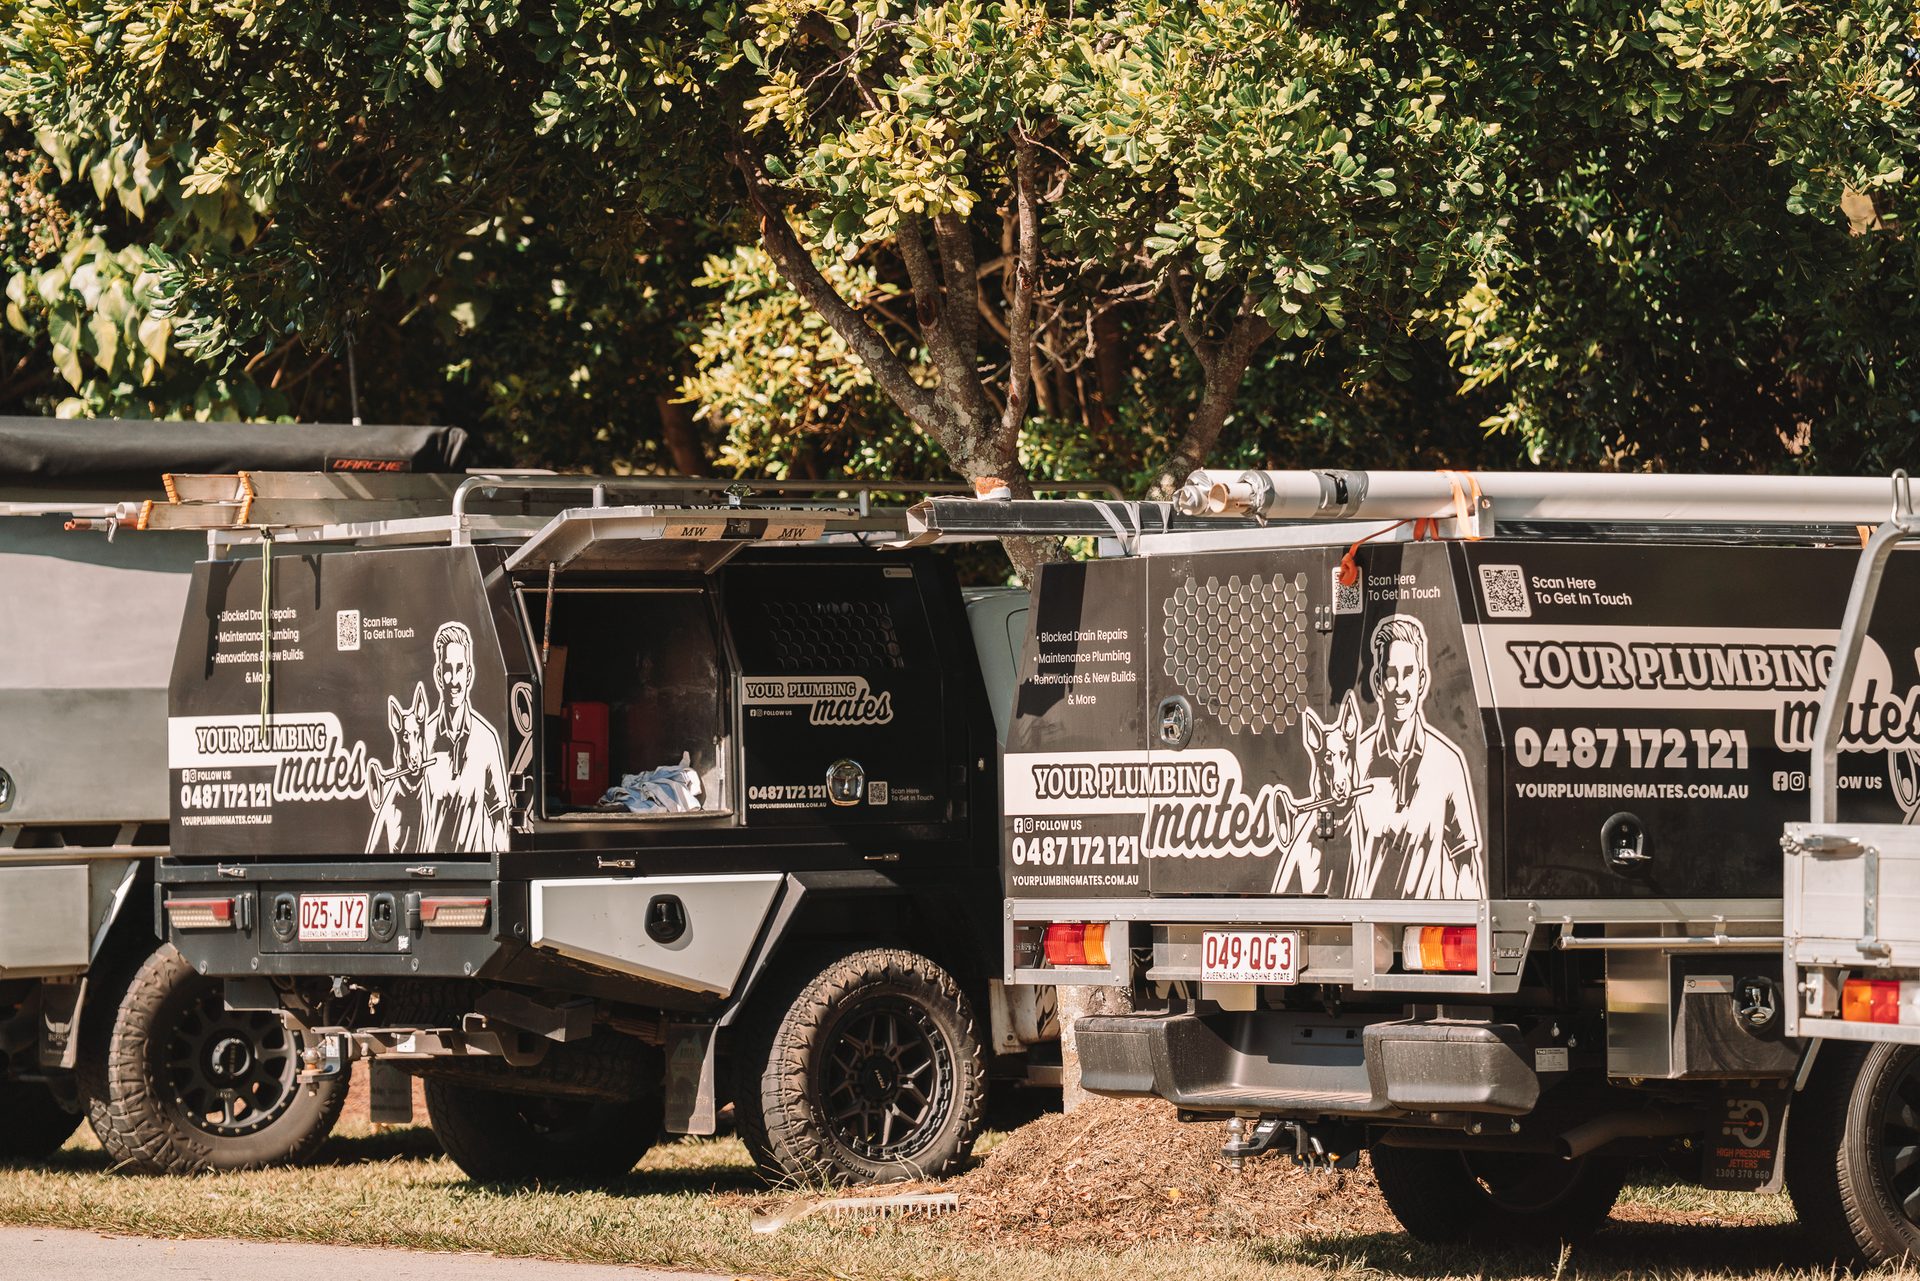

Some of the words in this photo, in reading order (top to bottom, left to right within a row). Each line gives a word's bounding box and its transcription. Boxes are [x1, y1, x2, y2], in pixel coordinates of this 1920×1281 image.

[333, 459, 403, 471] DARCHE
[1368, 576, 1396, 586] Scan
[1397, 575, 1416, 585] Here
[1532, 576, 1565, 590] Scan
[1568, 577, 1596, 590] Here
[1368, 590, 1380, 600] To
[1382, 589, 1398, 600] Get
[1400, 588, 1409, 599] In
[1411, 587, 1440, 598] Touch
[1534, 592, 1548, 604] To
[1550, 592, 1576, 604] Get
[1579, 592, 1591, 605] In
[1593, 592, 1632, 606] Touch
[221, 609, 249, 622] Blocked
[250, 608, 269, 620] Dra
[363, 618, 380, 628] Scan
[382, 617, 398, 626] Here
[219, 632, 264, 643] Maintenance
[363, 630, 372, 640] To
[373, 630, 386, 640] Get
[387, 629, 393, 639] In
[395, 628, 414, 638] Touch
[1041, 631, 1072, 642] Blocked
[1074, 630, 1096, 641] Drain
[1097, 628, 1128, 644] Repairs
[216, 652, 259, 663] Renovations
[282, 650, 304, 661] Builds
[1039, 652, 1090, 664] Maintenance
[1092, 650, 1130, 664] Plumbing
[1507, 641, 1629, 690] YOUR
[245, 672, 252, 683] &
[252, 672, 270, 683] Moe
[1034, 673, 1082, 684] Renovations
[1084, 672, 1090, 683] &
[1092, 672, 1110, 682] New
[1112, 670, 1136, 682] Builds
[746, 682, 784, 698] YOUR
[787, 682, 856, 698] PLUMBING
[812, 688, 890, 721] mates
[1068, 694, 1074, 704] &
[1076, 694, 1096, 704] More
[196, 726, 242, 754] YOUR
[1514, 726, 1618, 768] 0487
[1624, 728, 1688, 769] 172
[1690, 730, 1748, 769] 121
[277, 736, 366, 794] mates
[198, 771, 222, 780] FOLLOW
[222, 770, 232, 780] US
[1032, 764, 1096, 799] YOUR
[1098, 762, 1220, 798] PLUMBING
[1865, 776, 1882, 789] US
[181, 784, 221, 809] 0487
[222, 784, 248, 808] 172
[249, 783, 272, 808] 121
[749, 786, 782, 800] 0487
[784, 786, 806, 799] 172
[808, 785, 826, 798] 121
[1516, 784, 1748, 800] YOURPLUMBINGMATES.COM.AU
[749, 802, 826, 810] YOURPLUMBINGMATES.COM.AU
[181, 814, 272, 826] YOURPLUMBINGMATES.COM.AU
[1149, 778, 1274, 850] mates
[1036, 820, 1069, 831] FOLLOW
[1070, 820, 1082, 831] US
[1012, 836, 1068, 866] 0487
[1070, 836, 1104, 865] 172
[1108, 836, 1138, 865] 121
[1012, 875, 1138, 886] YOURPLUMBINGMATES.COM.AU
[1206, 972, 1240, 980] QUEENSLAND
[1244, 972, 1271, 980] SUNSHINE
[1274, 972, 1290, 980] STATE
[1716, 1148, 1734, 1157] HIGH
[1735, 1148, 1772, 1159] PRESSURE
[1728, 1160, 1758, 1169] JETTERS
[1716, 1168, 1735, 1178] 1300
[1737, 1170, 1752, 1178] 370
